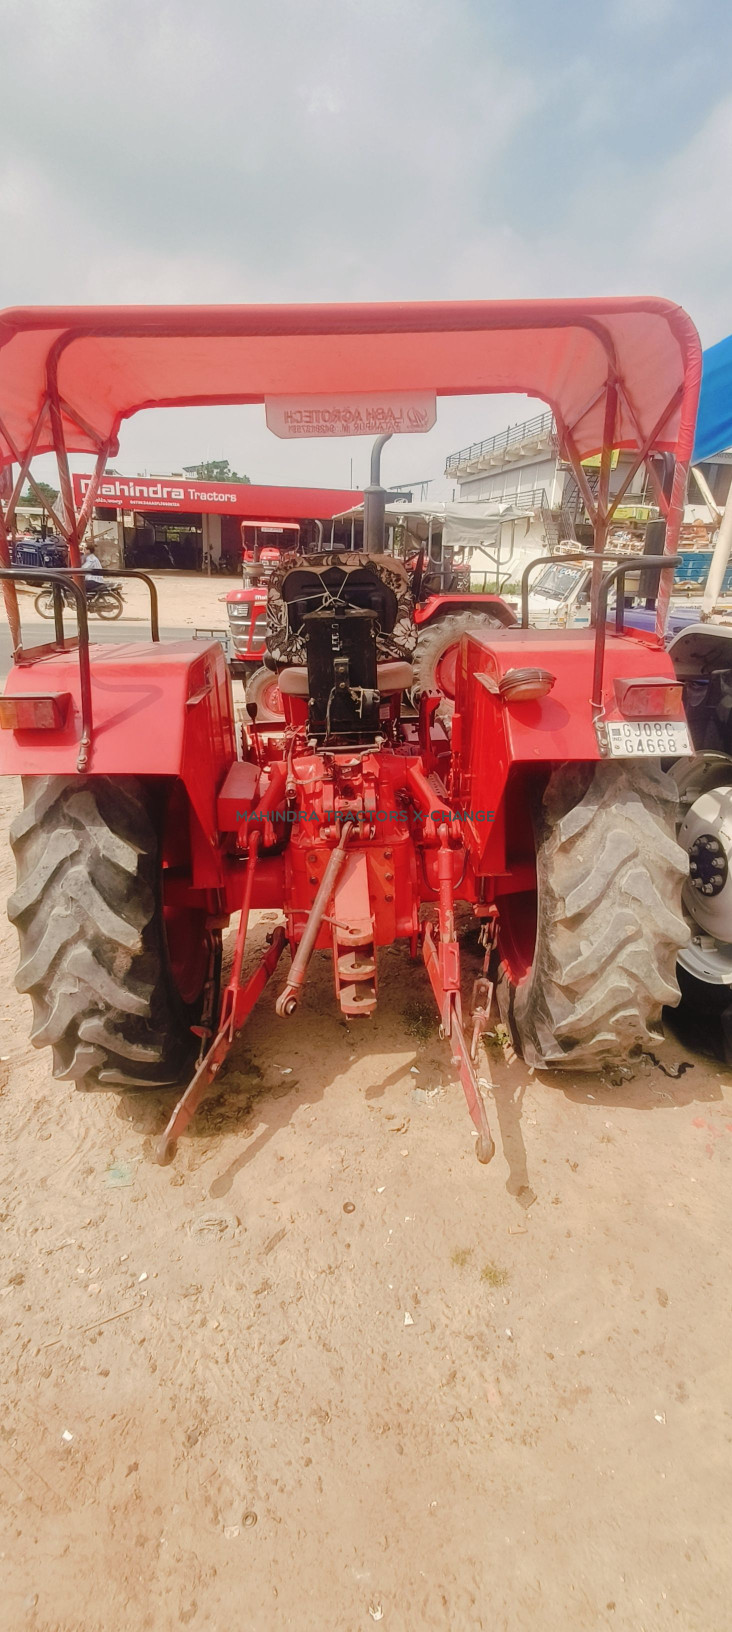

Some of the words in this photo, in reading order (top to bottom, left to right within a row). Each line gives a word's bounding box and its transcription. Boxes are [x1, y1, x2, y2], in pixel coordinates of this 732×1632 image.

[188, 489, 237, 502] Tractors
[623, 723, 674, 737] GJ08C
[625, 739, 676, 753] G4668
